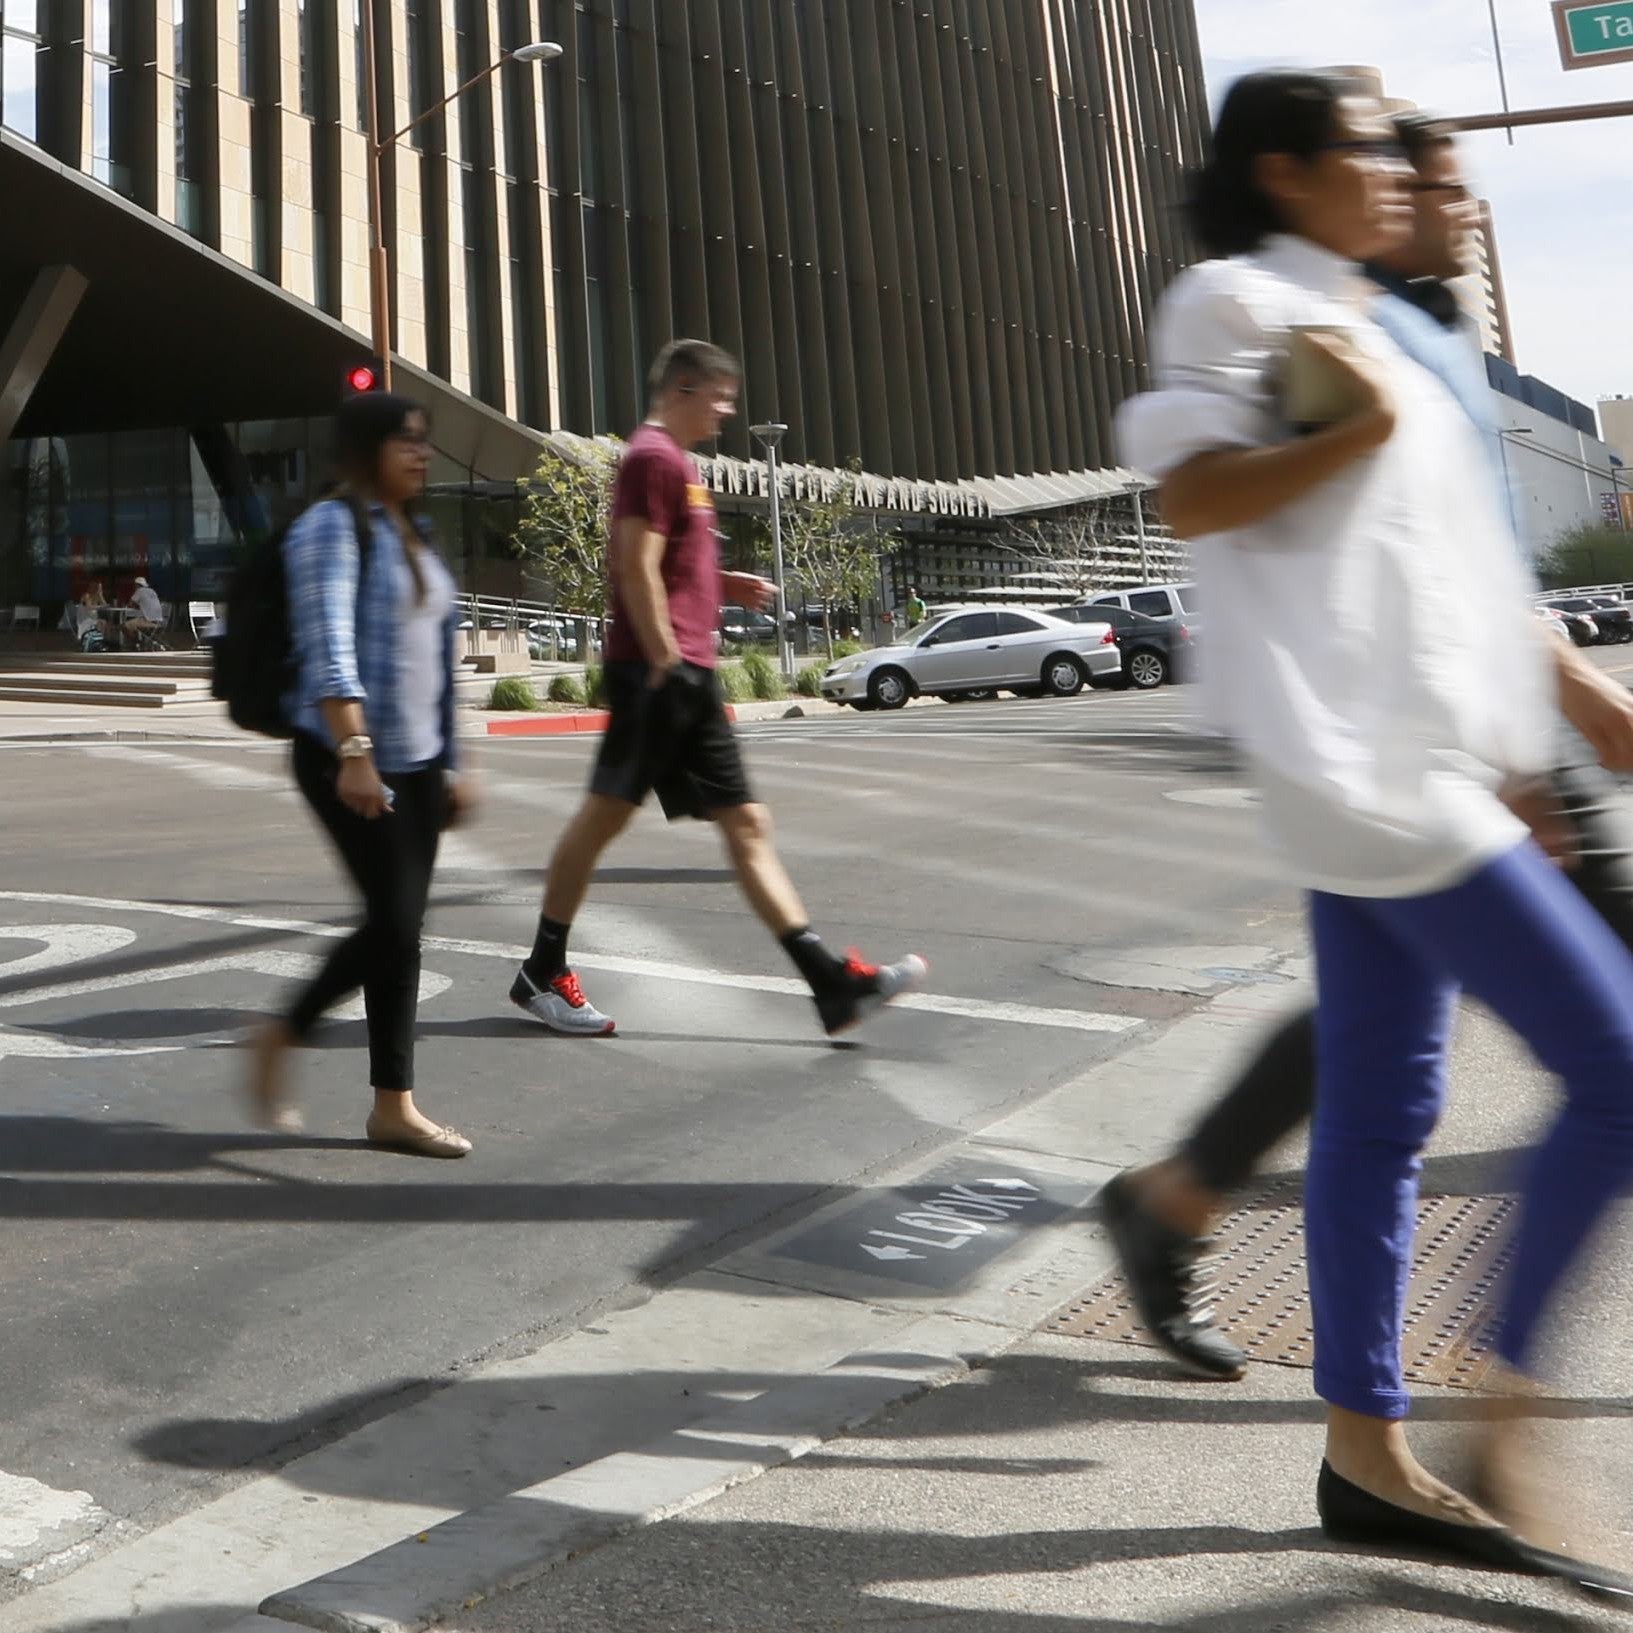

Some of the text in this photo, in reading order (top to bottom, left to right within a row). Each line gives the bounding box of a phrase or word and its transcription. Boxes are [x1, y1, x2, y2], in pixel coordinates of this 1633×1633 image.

[1593, 15, 1633, 39] Ta
[794, 471, 832, 504] FOR
[886, 480, 920, 513] AND
[927, 485, 993, 519] SOCIETY
[867, 1184, 1037, 1250] LOOK
